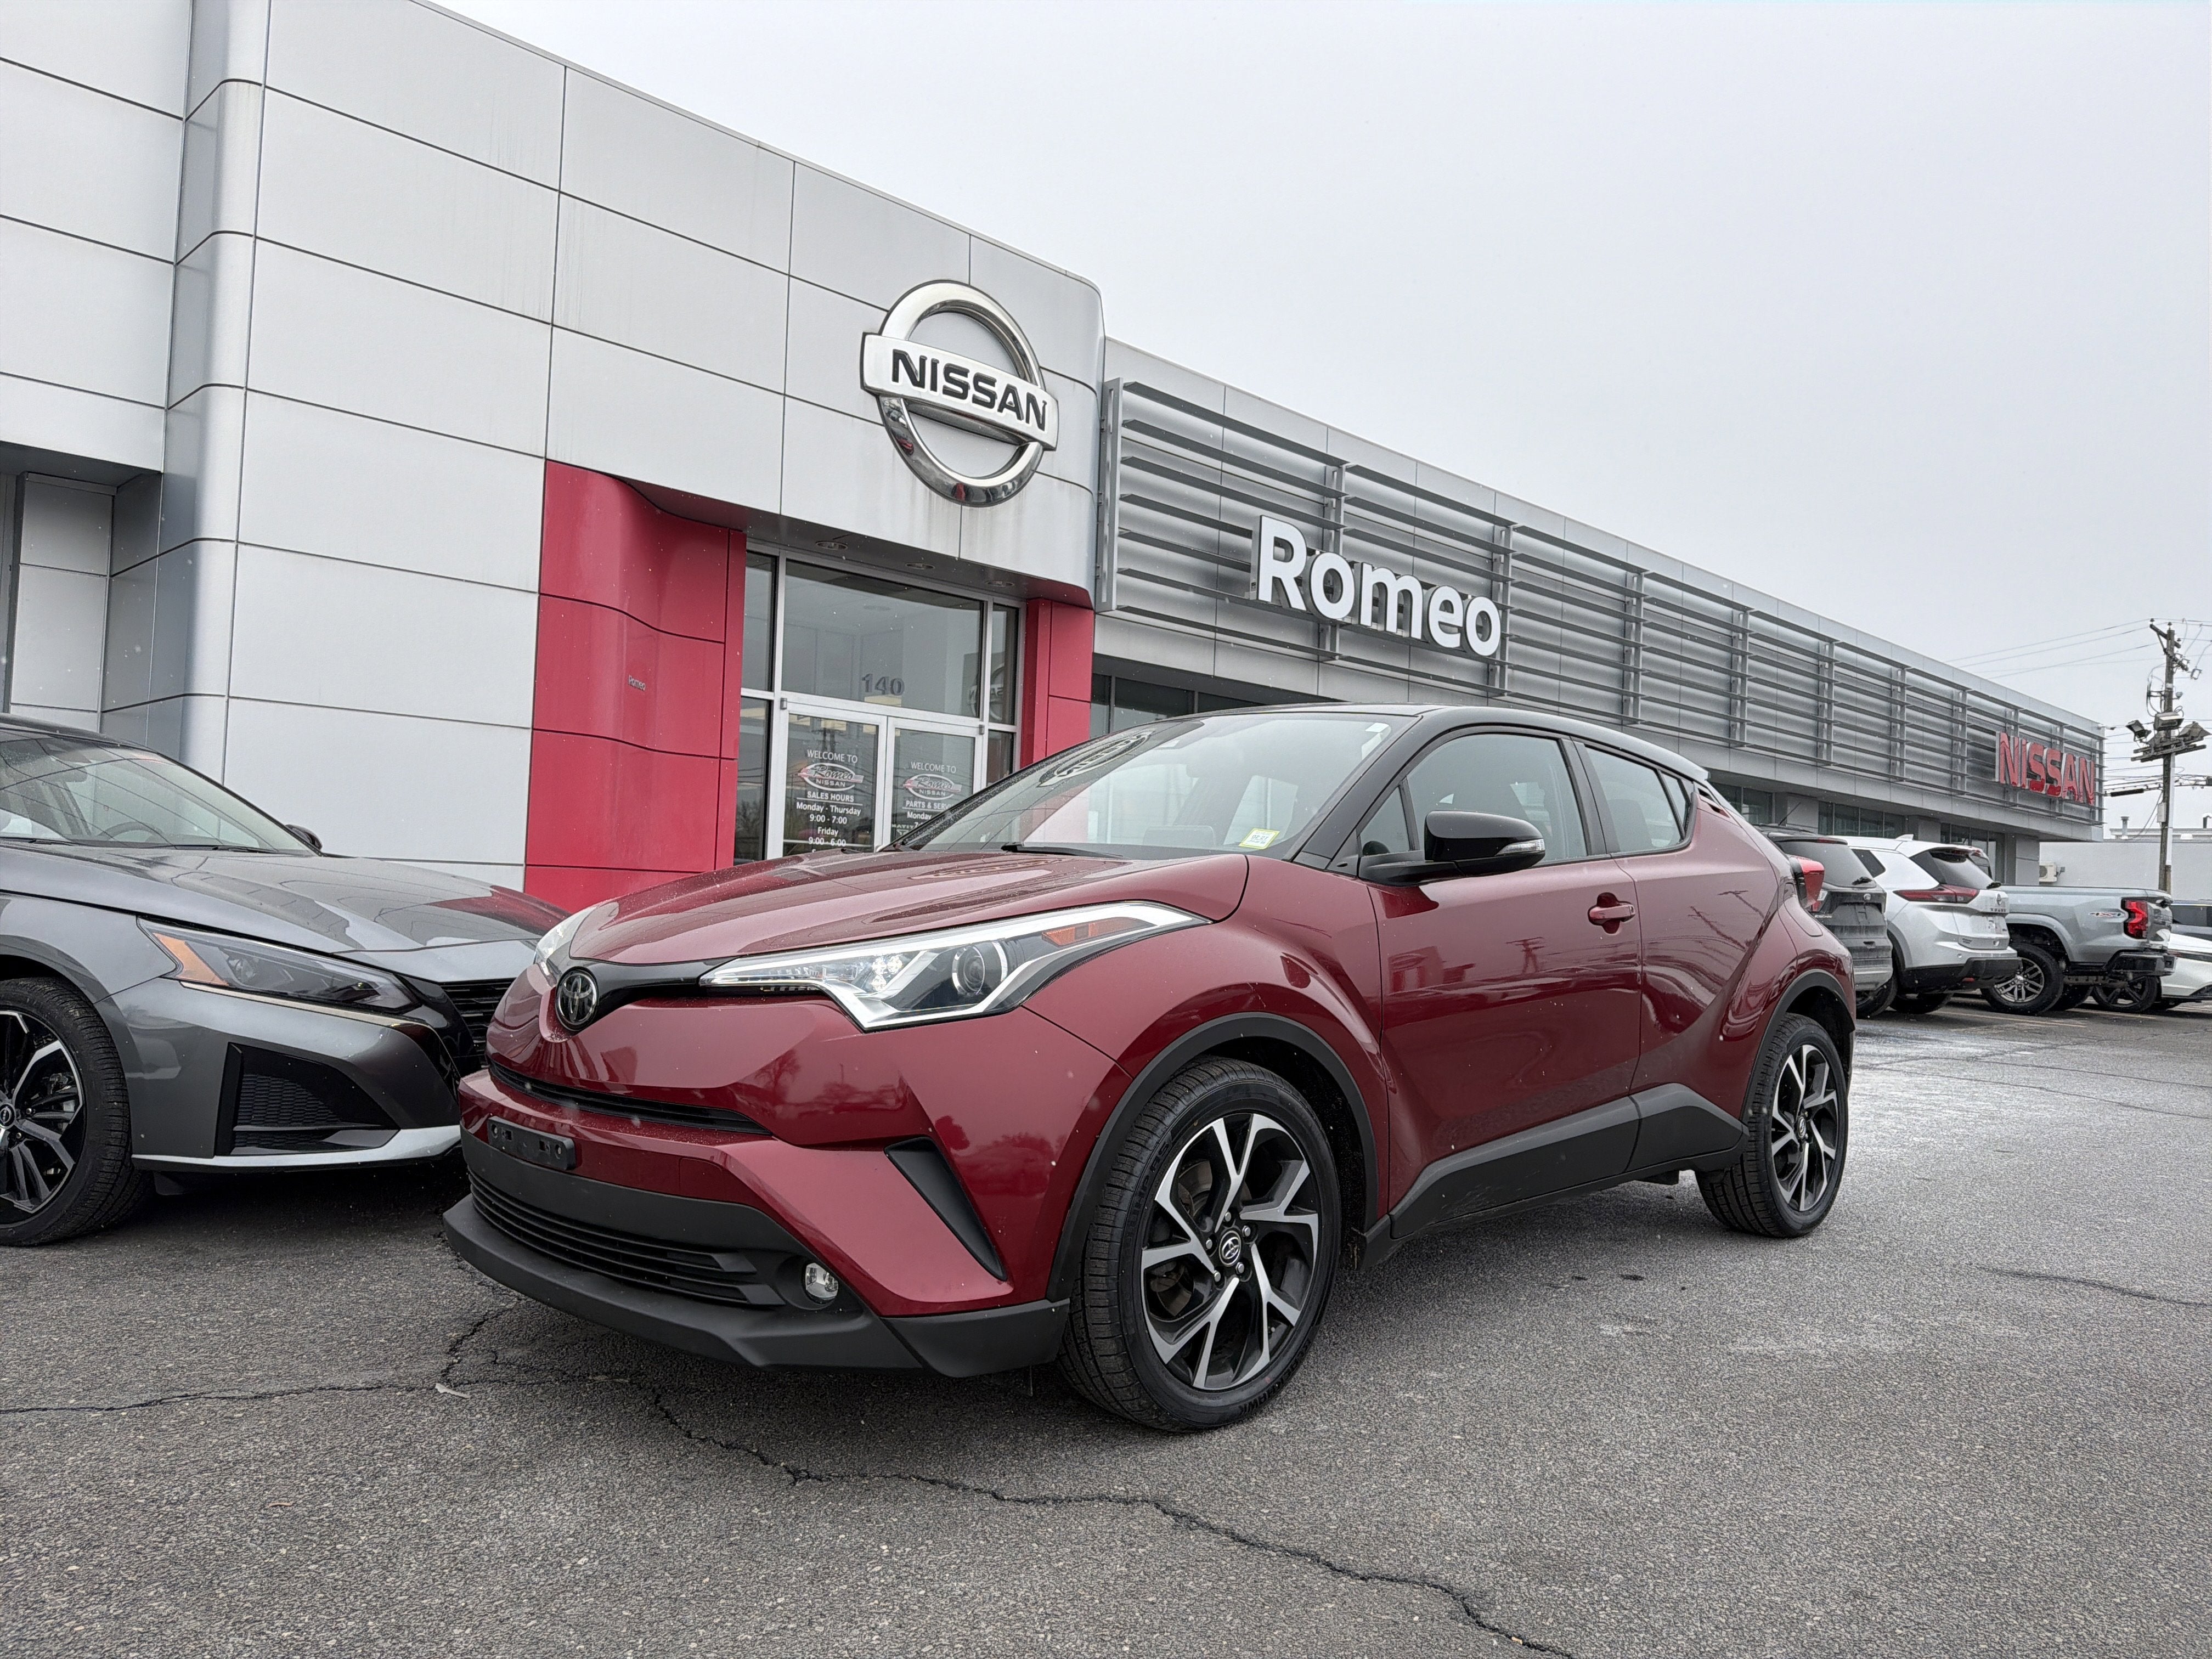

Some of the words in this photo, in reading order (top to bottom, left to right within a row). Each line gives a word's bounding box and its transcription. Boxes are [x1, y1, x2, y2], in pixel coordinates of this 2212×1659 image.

[891, 349, 1048, 431] NISSAN
[1256, 515, 1501, 656] Romeo
[861, 673, 904, 696] 140
[807, 749, 845, 762] WELCOME
[847, 754, 858, 764] TO
[810, 764, 854, 780] Romeo
[911, 761, 944, 772] WELCOME
[1997, 732, 2095, 806] NISSAN
[915, 775, 953, 790] Romeo
[807, 791, 828, 799] SALES
[831, 794, 854, 802] HOURS
[797, 802, 824, 812] Monday
[830, 805, 861, 816] Thursday
[906, 800, 926, 809] PARTS
[810, 814, 826, 823] 9:00
[832, 816, 847, 824] 7:00
[907, 811, 932, 820] Monday
[817, 827, 839, 837] Friday
[809, 837, 824, 845] 9:00
[831, 838, 847, 847] 6:00
